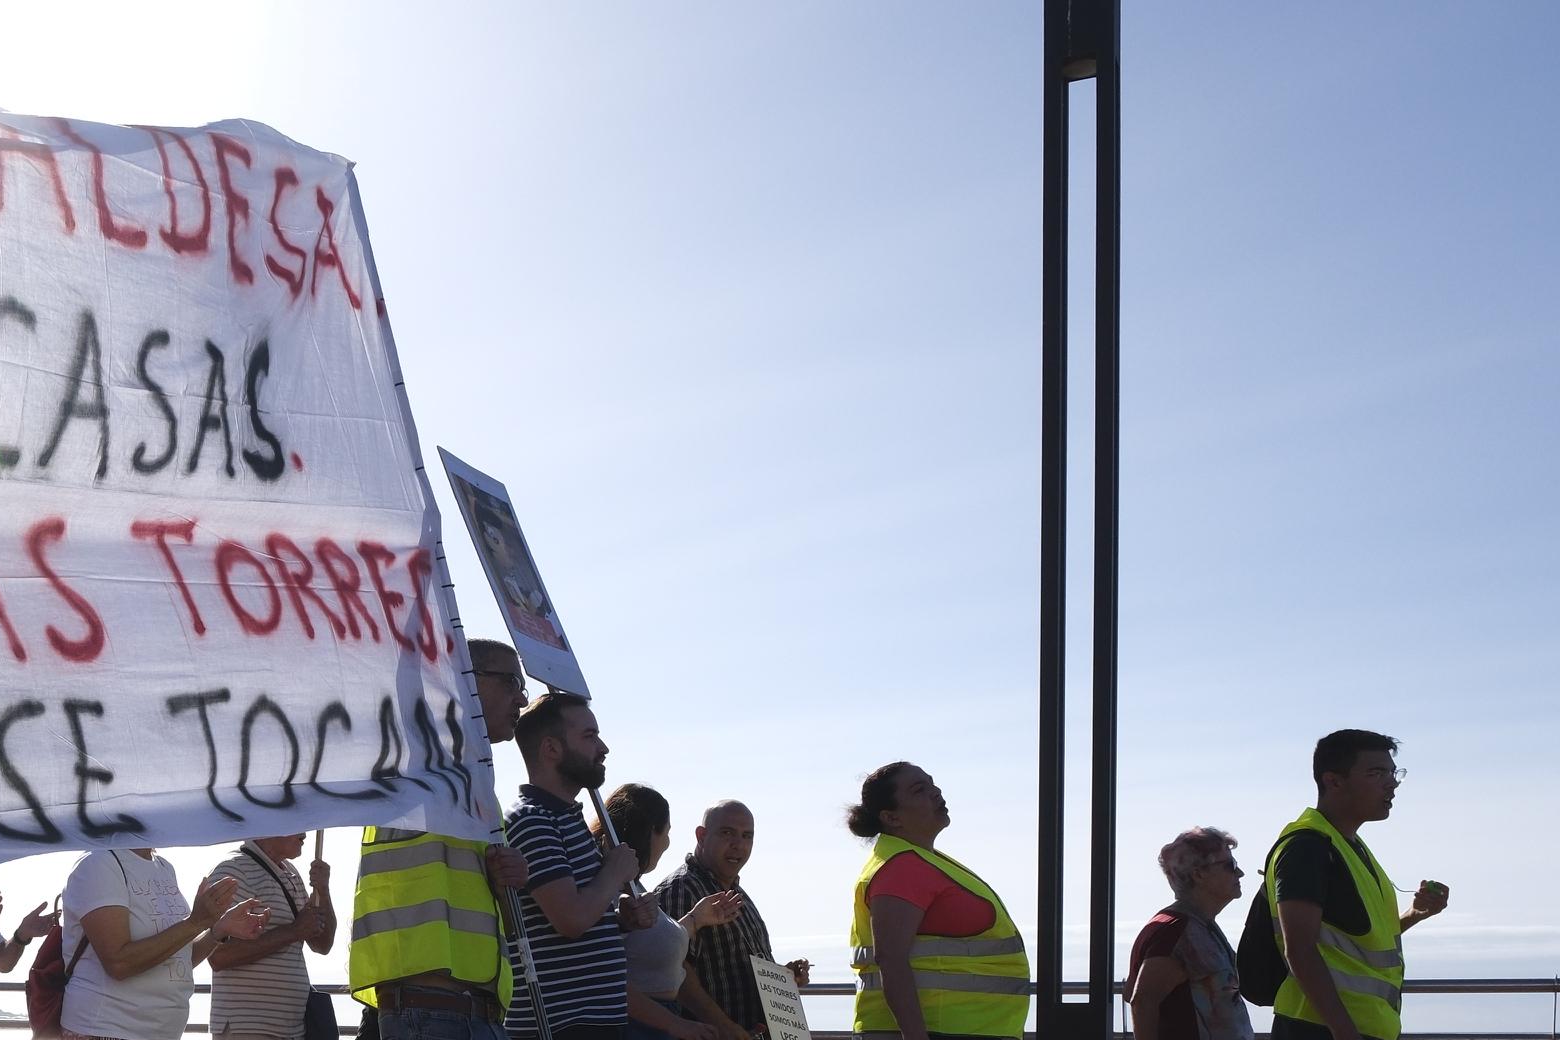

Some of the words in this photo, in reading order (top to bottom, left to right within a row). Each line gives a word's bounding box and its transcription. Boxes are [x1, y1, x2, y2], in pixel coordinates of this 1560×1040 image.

[762, 969, 787, 983] BARRIO
[760, 983, 772, 993] LAS
[772, 986, 798, 1000] TORRES
[769, 1000, 796, 1015] UNIDOS
[768, 1013, 791, 1027] SOMOS
